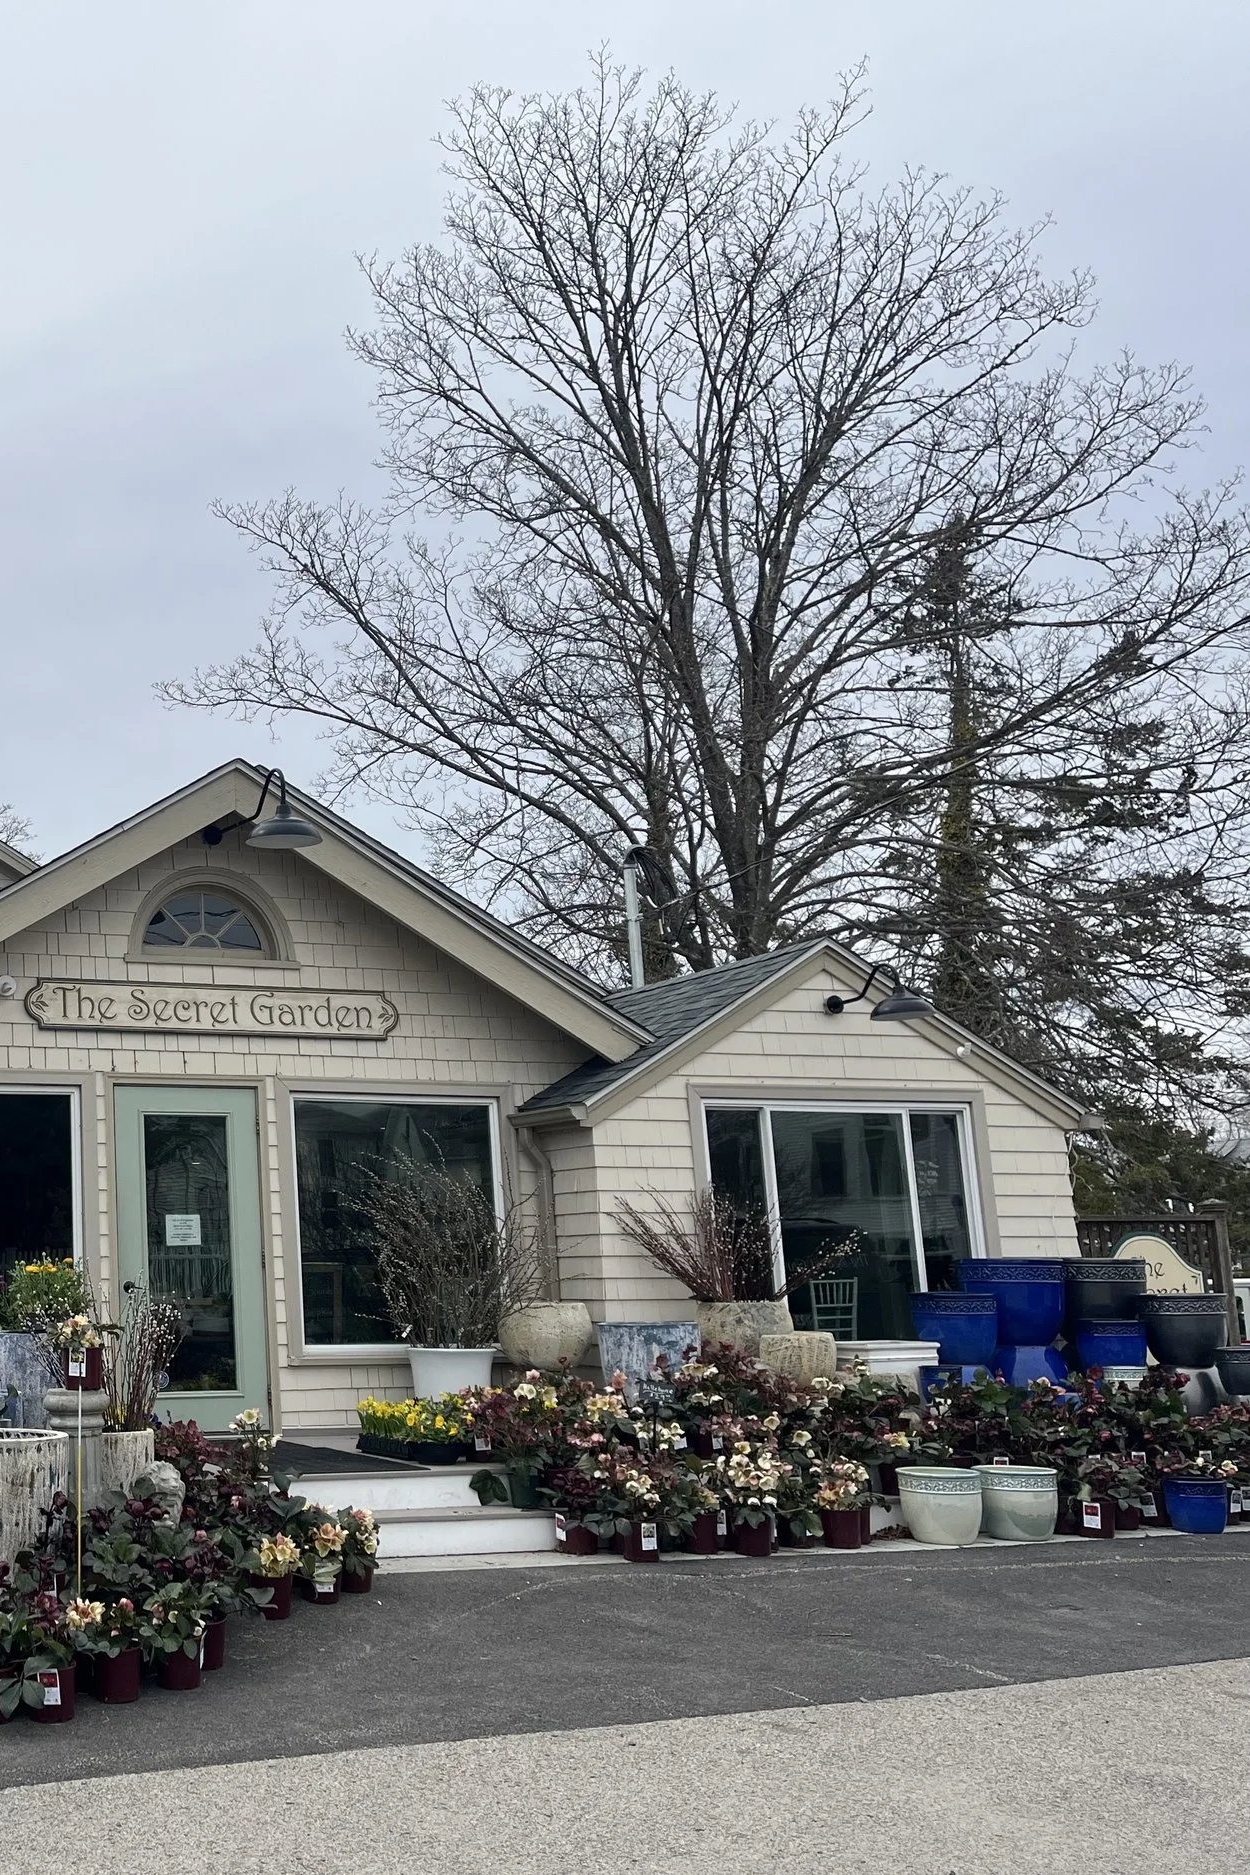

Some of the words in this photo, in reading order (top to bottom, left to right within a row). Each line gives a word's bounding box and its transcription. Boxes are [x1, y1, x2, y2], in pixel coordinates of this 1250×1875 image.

[52, 984, 118, 1024] The
[127, 988, 239, 1028] Secret
[249, 992, 373, 1032] Garden
